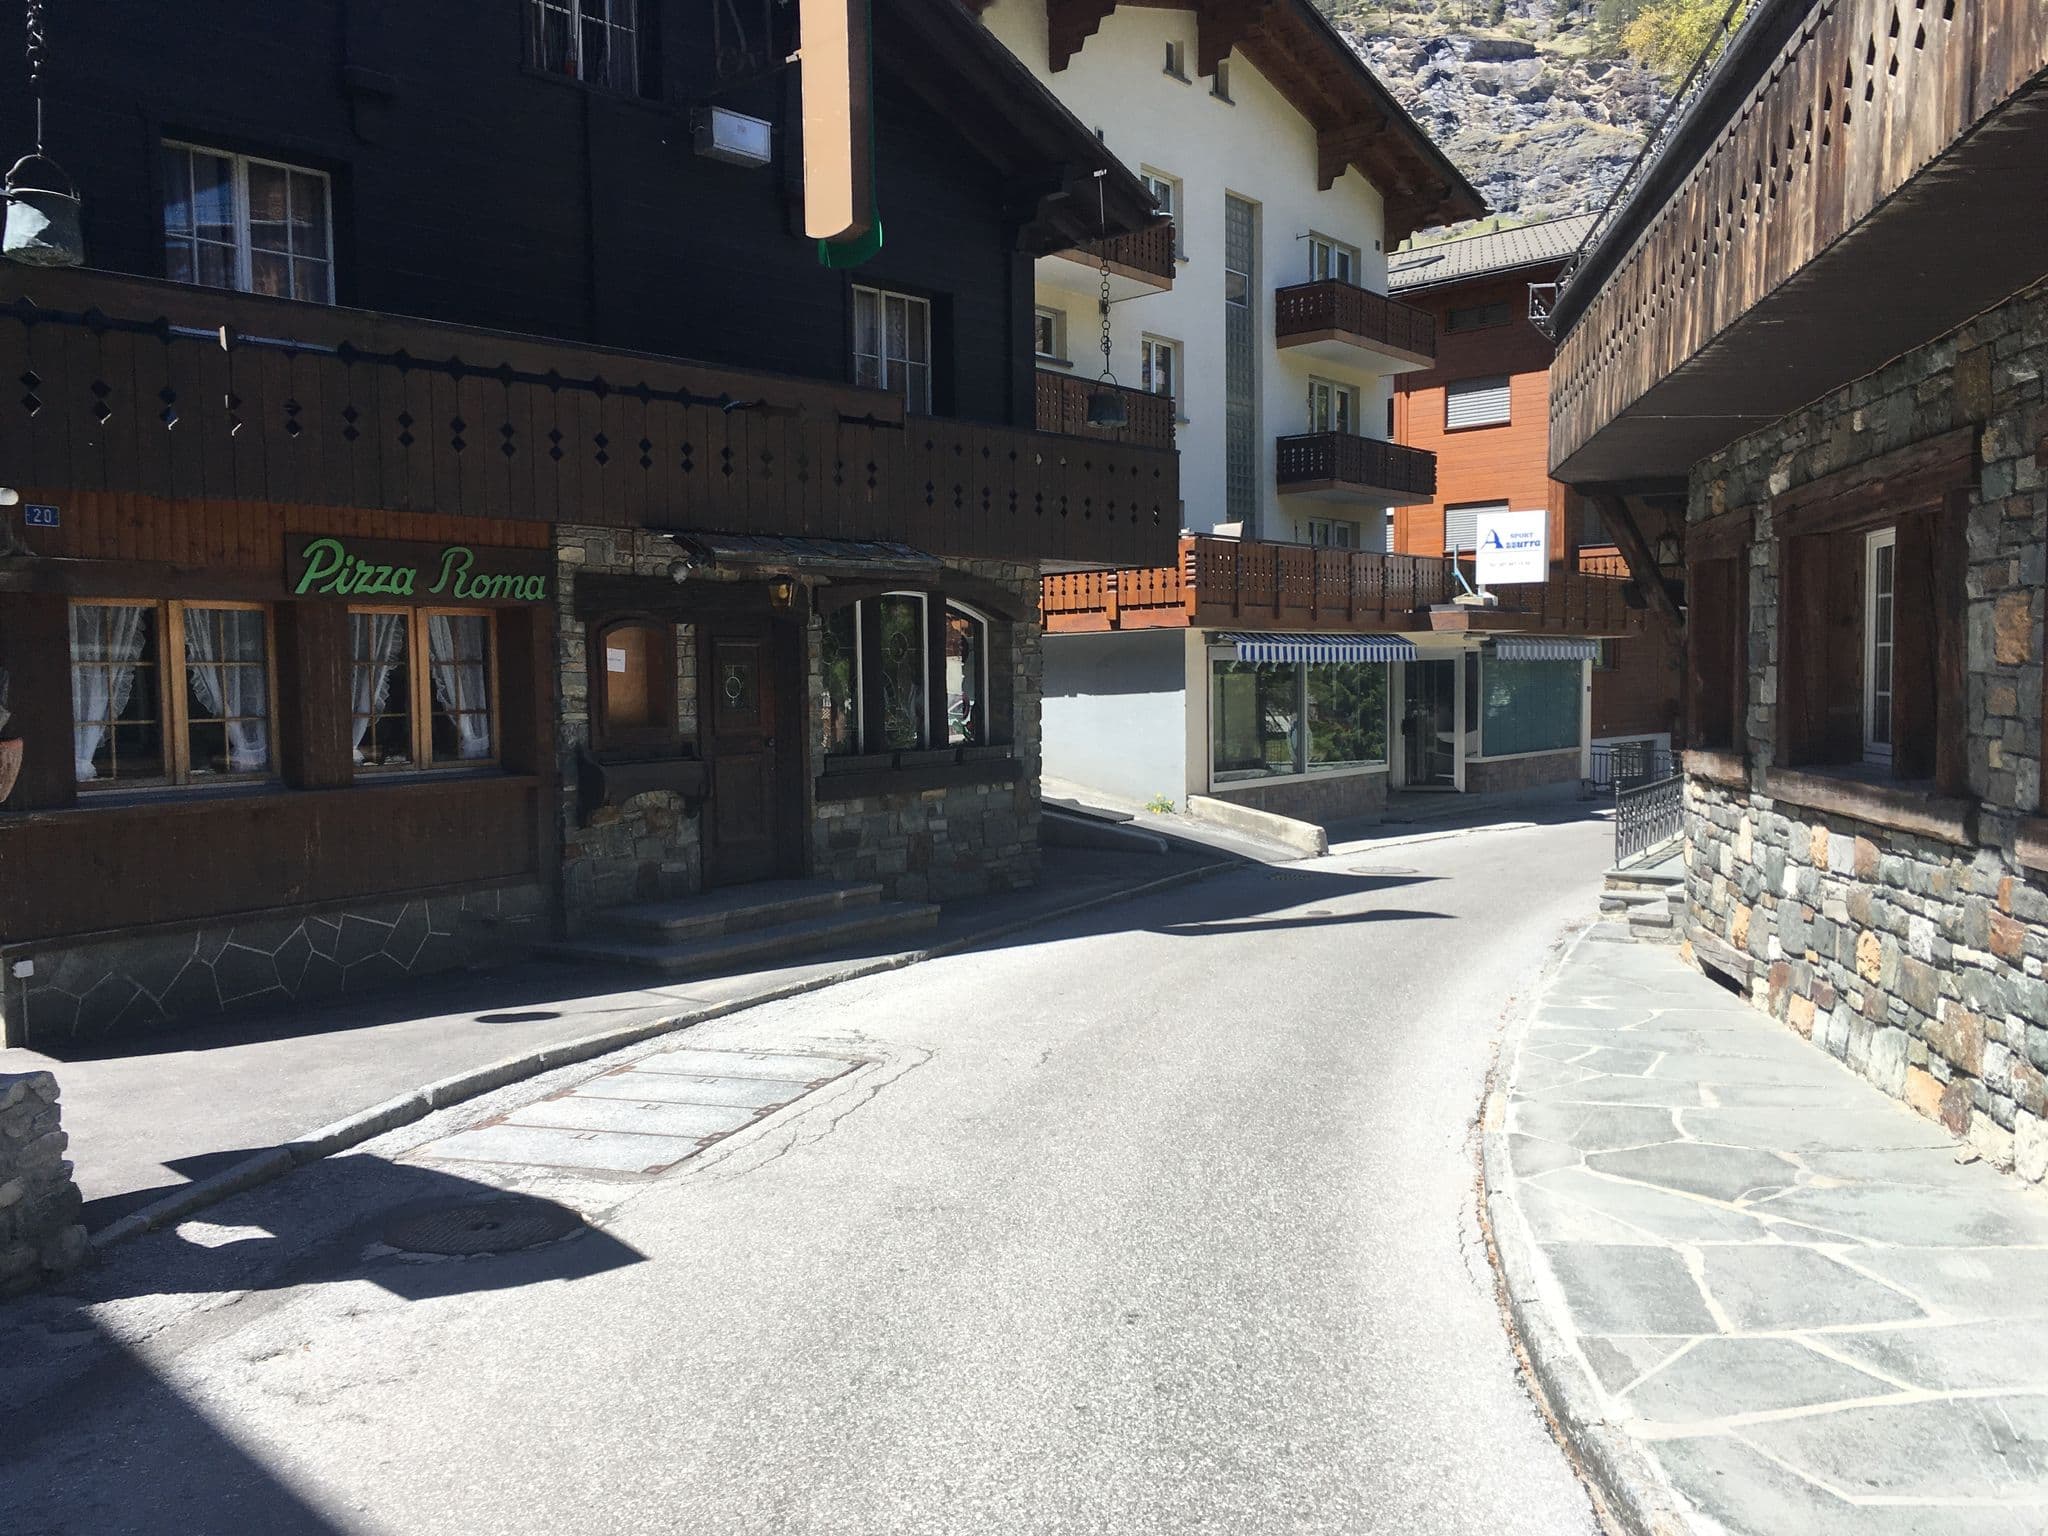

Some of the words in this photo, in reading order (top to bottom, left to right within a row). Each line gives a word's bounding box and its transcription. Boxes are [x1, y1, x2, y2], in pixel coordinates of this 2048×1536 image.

[33, 508, 52, 523] 20
[295, 538, 416, 595] Pizza
[428, 546, 546, 600] Roma
